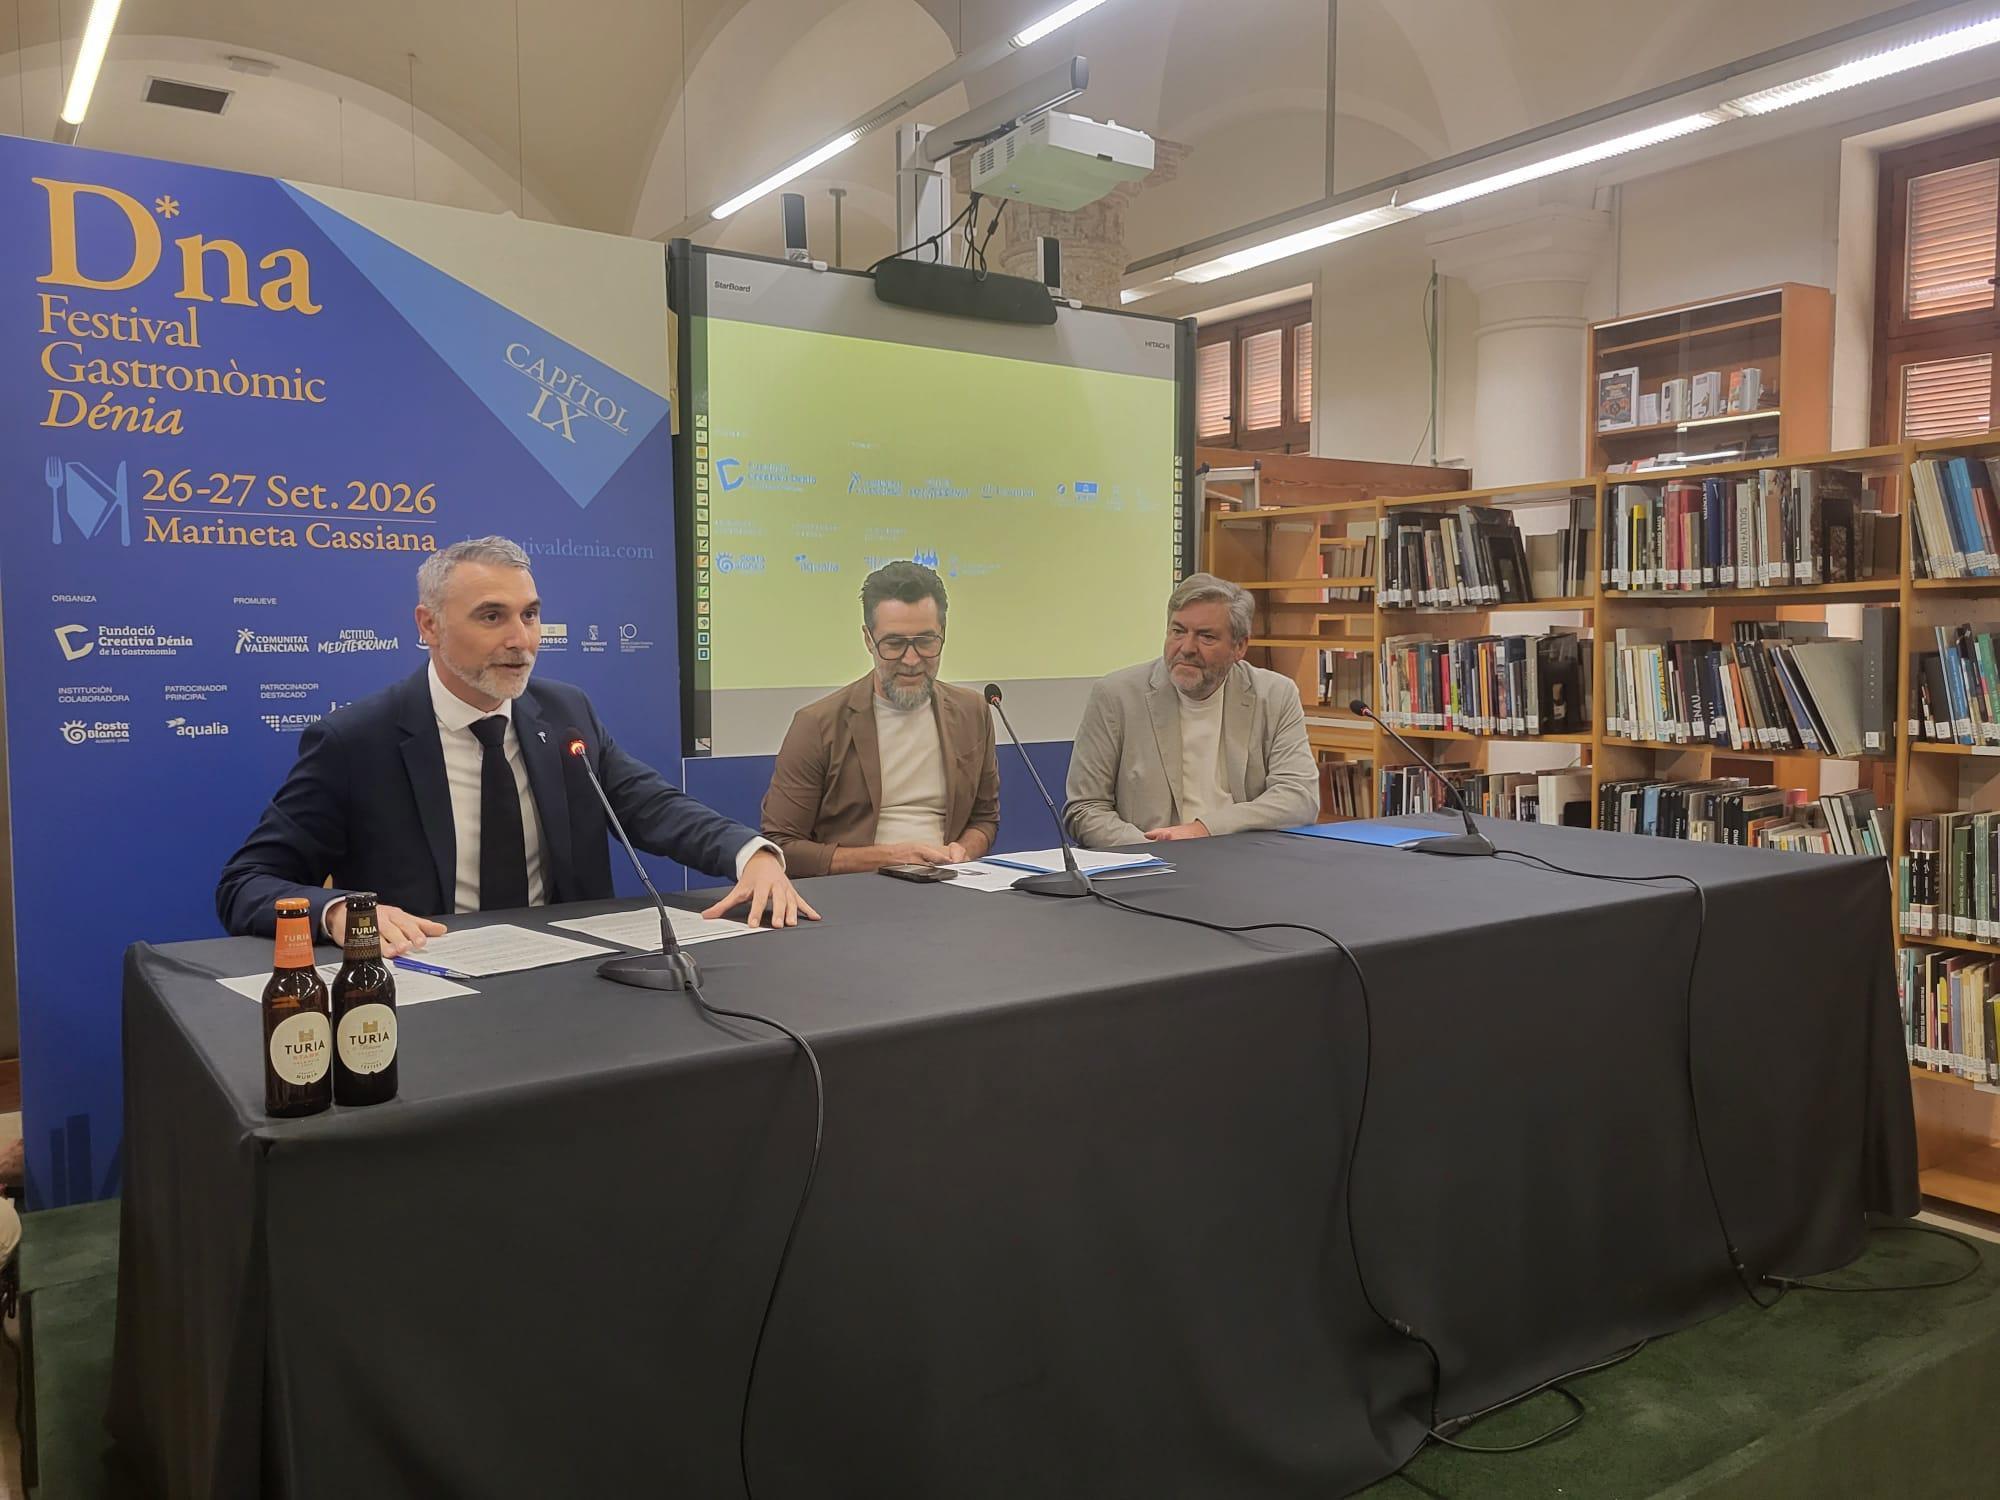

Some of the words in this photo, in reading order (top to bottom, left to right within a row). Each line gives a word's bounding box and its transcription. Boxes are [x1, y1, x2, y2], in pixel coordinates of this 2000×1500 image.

[714, 281, 750, 292] StarBoard
[37, 294, 201, 349] Festival
[41, 342, 326, 404] Gastronòmic
[503, 342, 631, 435] CAPÍTOL
[40, 390, 184, 436] Dénia
[527, 386, 592, 444] IX
[142, 468, 255, 507] 26-27
[266, 475, 339, 510] Set.
[348, 480, 436, 515] 2026
[143, 516, 295, 547] Marineta
[305, 522, 437, 552] Cassiana
[523, 538, 654, 559] tivaldenia.com
[52, 595, 97, 603] ORGANIZA
[233, 597, 277, 605] PROMUEVE
[99, 625, 155, 636] Fundació
[339, 630, 374, 640] ACTITUD
[99, 636, 154, 646] Creativa
[157, 636, 193, 646] Dénia
[256, 636, 308, 644] COMUNITAT
[244, 644, 309, 652] VALENCIANA
[58, 686, 112, 694] INSTITUCIÓN
[58, 695, 129, 703] COLABORADORA
[95, 722, 129, 730] Costa
[177, 723, 229, 738] aqualia
[87, 730, 129, 738] Blanca
[352, 926, 377, 935] TURIA
[284, 934, 309, 942] TURIA
[349, 1032, 389, 1045] TURIA
[285, 1040, 325, 1055] TURIA
